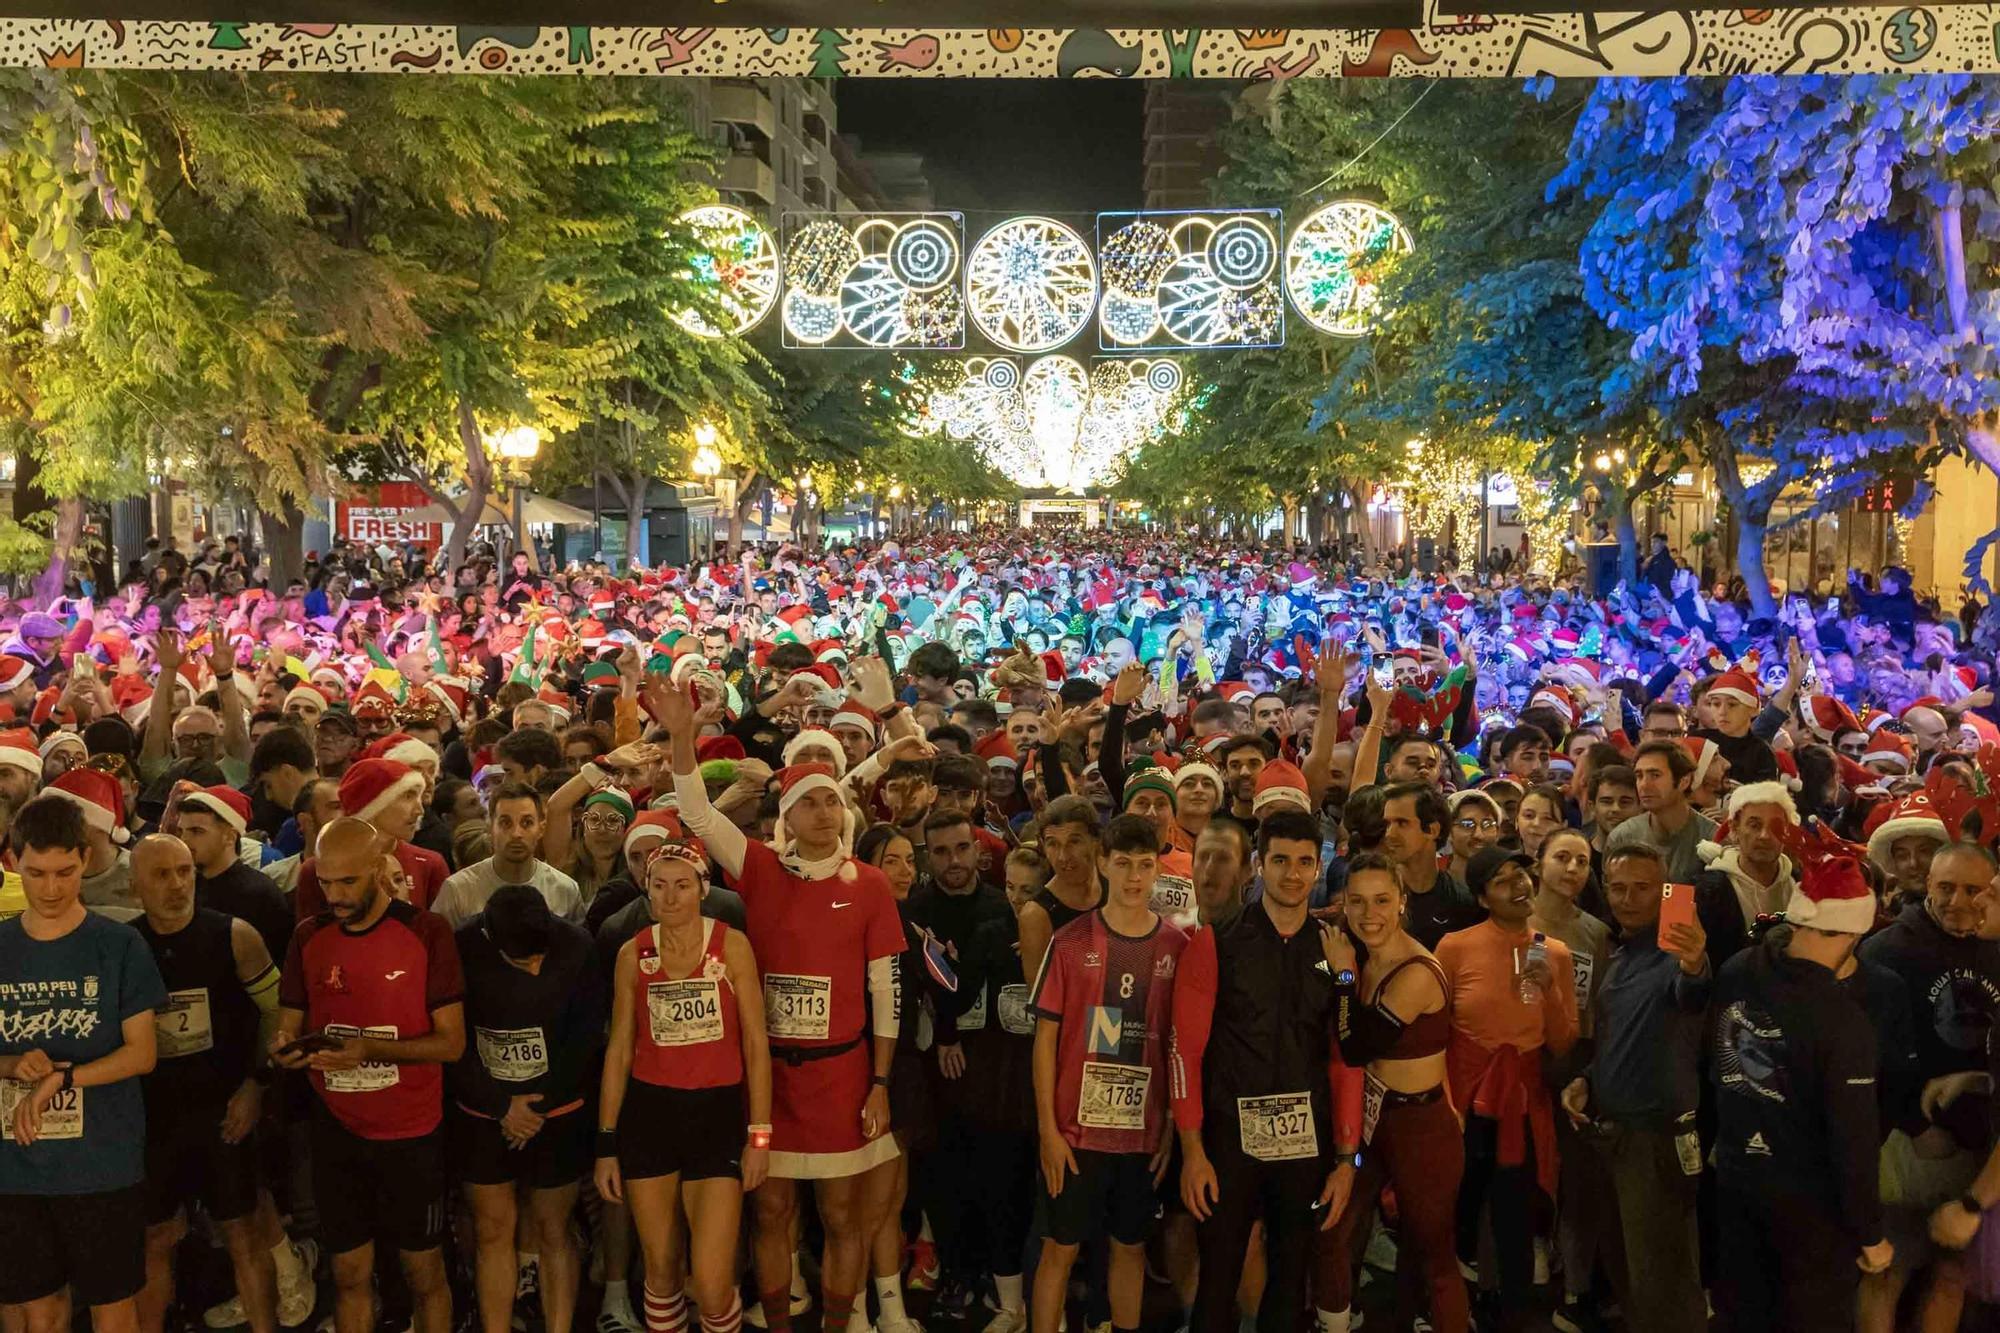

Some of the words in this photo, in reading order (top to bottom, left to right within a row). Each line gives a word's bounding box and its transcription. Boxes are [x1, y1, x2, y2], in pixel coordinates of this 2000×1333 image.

[300, 41, 378, 66] FAST!
[1697, 42, 1758, 75] RUN
[348, 507, 398, 518] FREHER
[352, 519, 428, 538] FRESH
[1166, 890, 1188, 908] 597
[0, 982, 37, 995] OLTA
[50, 980, 78, 992] PEU
[1119, 973, 1135, 998] 8
[672, 998, 717, 1022] 2804
[785, 996, 825, 1016] 3113
[179, 1012, 189, 1032] 2
[502, 1044, 542, 1061] 2186
[43, 1088, 77, 1112] 02
[1106, 1085, 1144, 1106] 1785
[1268, 1112, 1308, 1137] 1327
